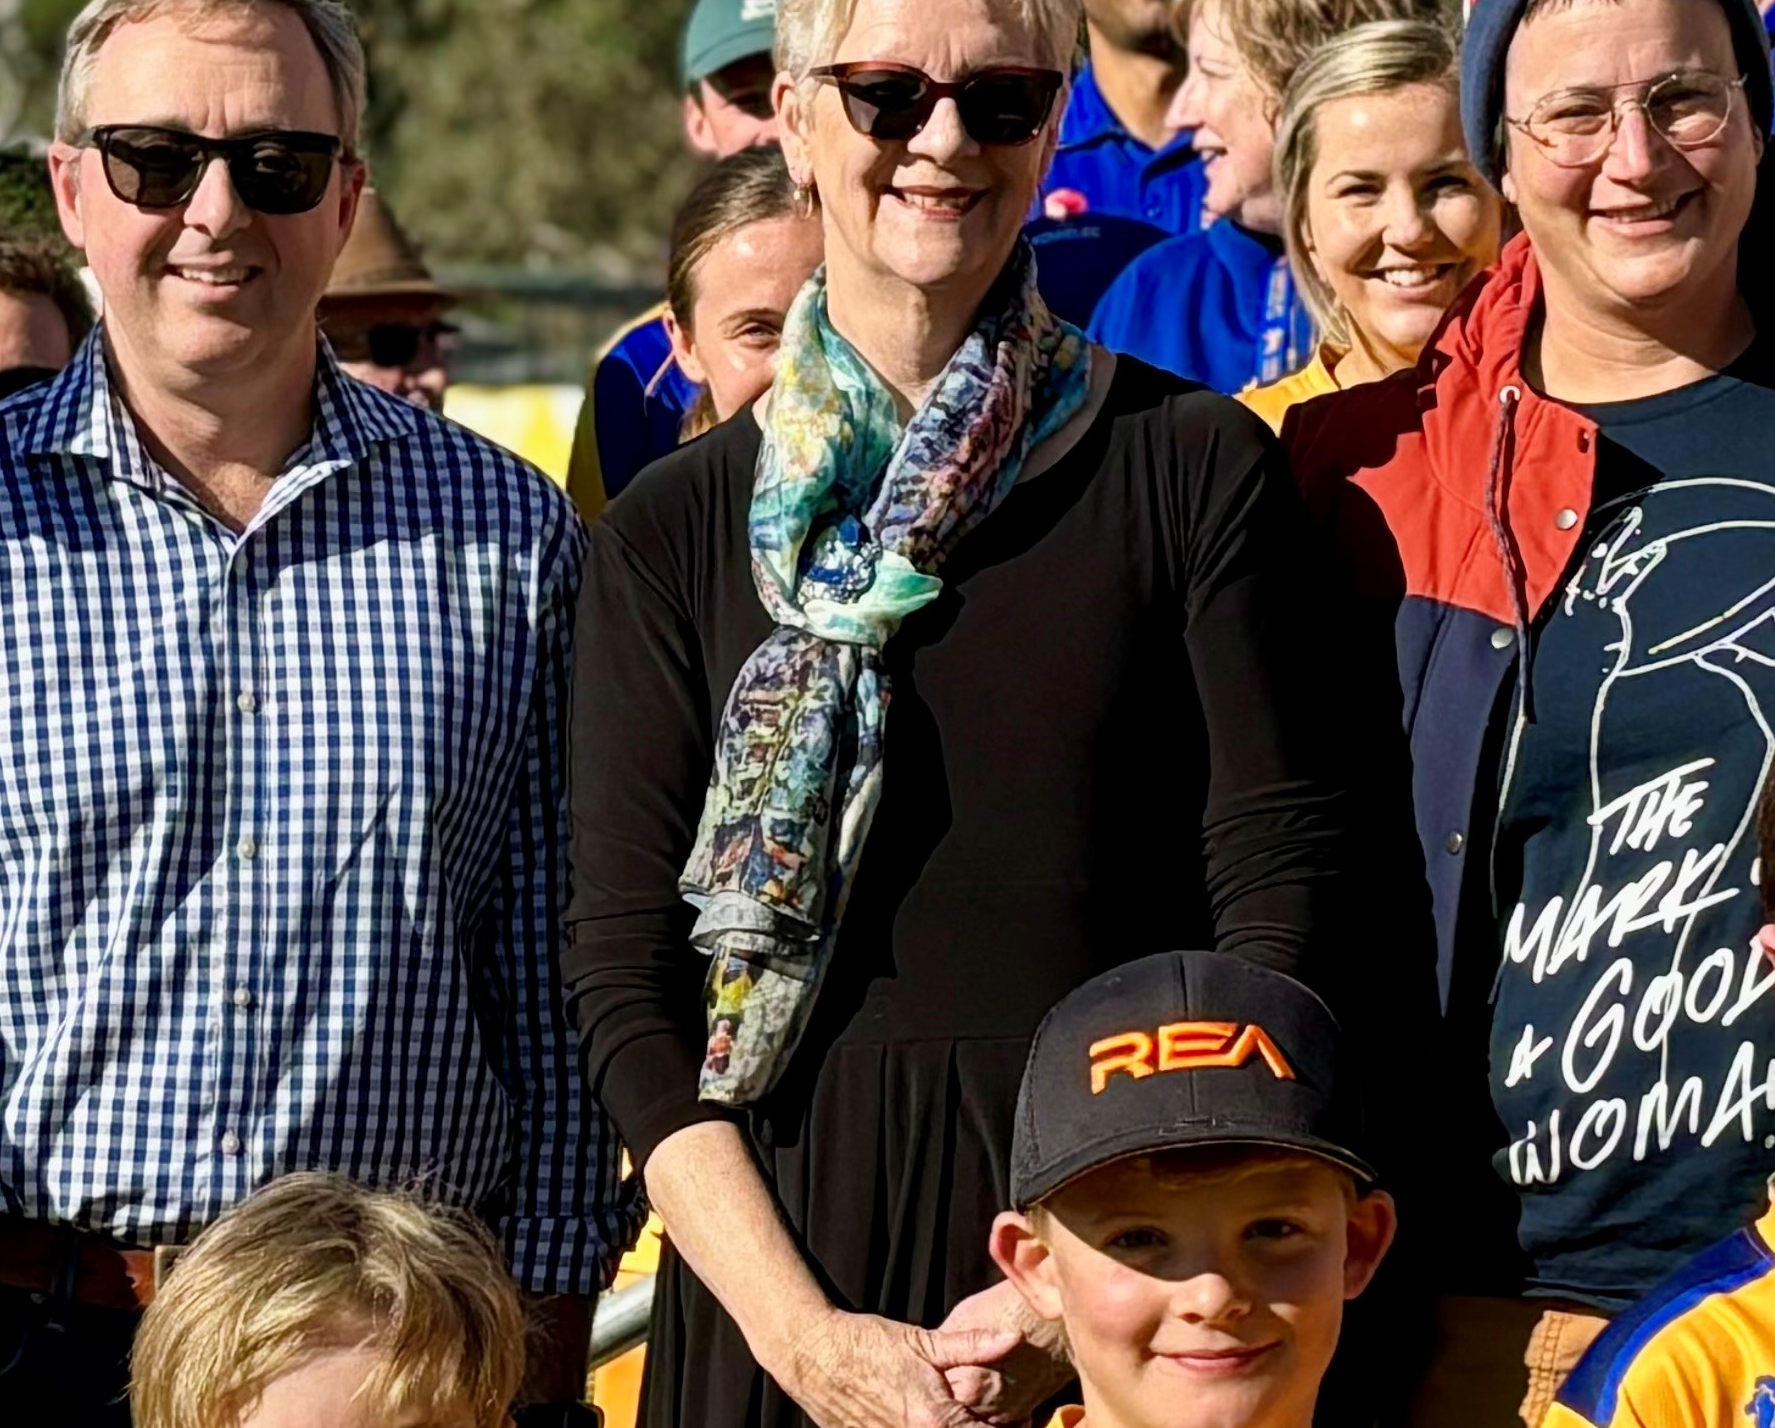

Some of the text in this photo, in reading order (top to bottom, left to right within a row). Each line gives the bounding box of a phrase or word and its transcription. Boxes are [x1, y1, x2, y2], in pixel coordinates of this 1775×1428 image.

[1587, 757, 1716, 855] THE
[1509, 843, 1741, 984] MARK
[1089, 1021, 1297, 1096] REA
